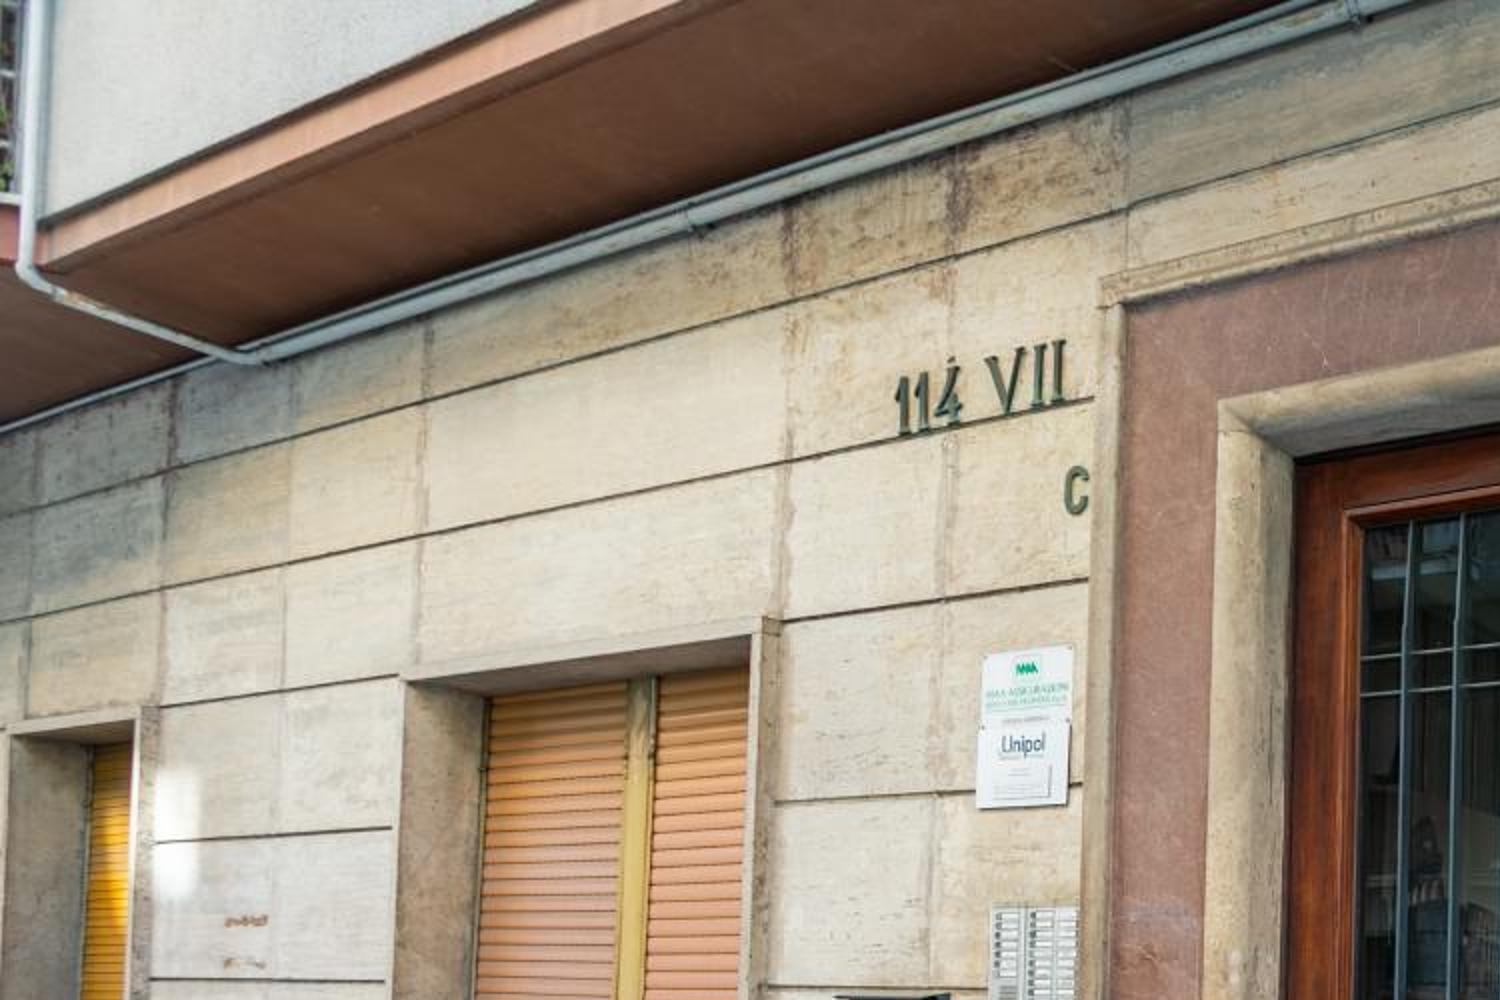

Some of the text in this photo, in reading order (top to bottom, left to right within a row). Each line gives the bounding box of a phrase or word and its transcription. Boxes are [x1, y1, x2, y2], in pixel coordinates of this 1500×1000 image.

[895, 339, 1067, 436] 114 VII
[1064, 464, 1090, 516] C
[1001, 730, 1047, 759] Unipol
